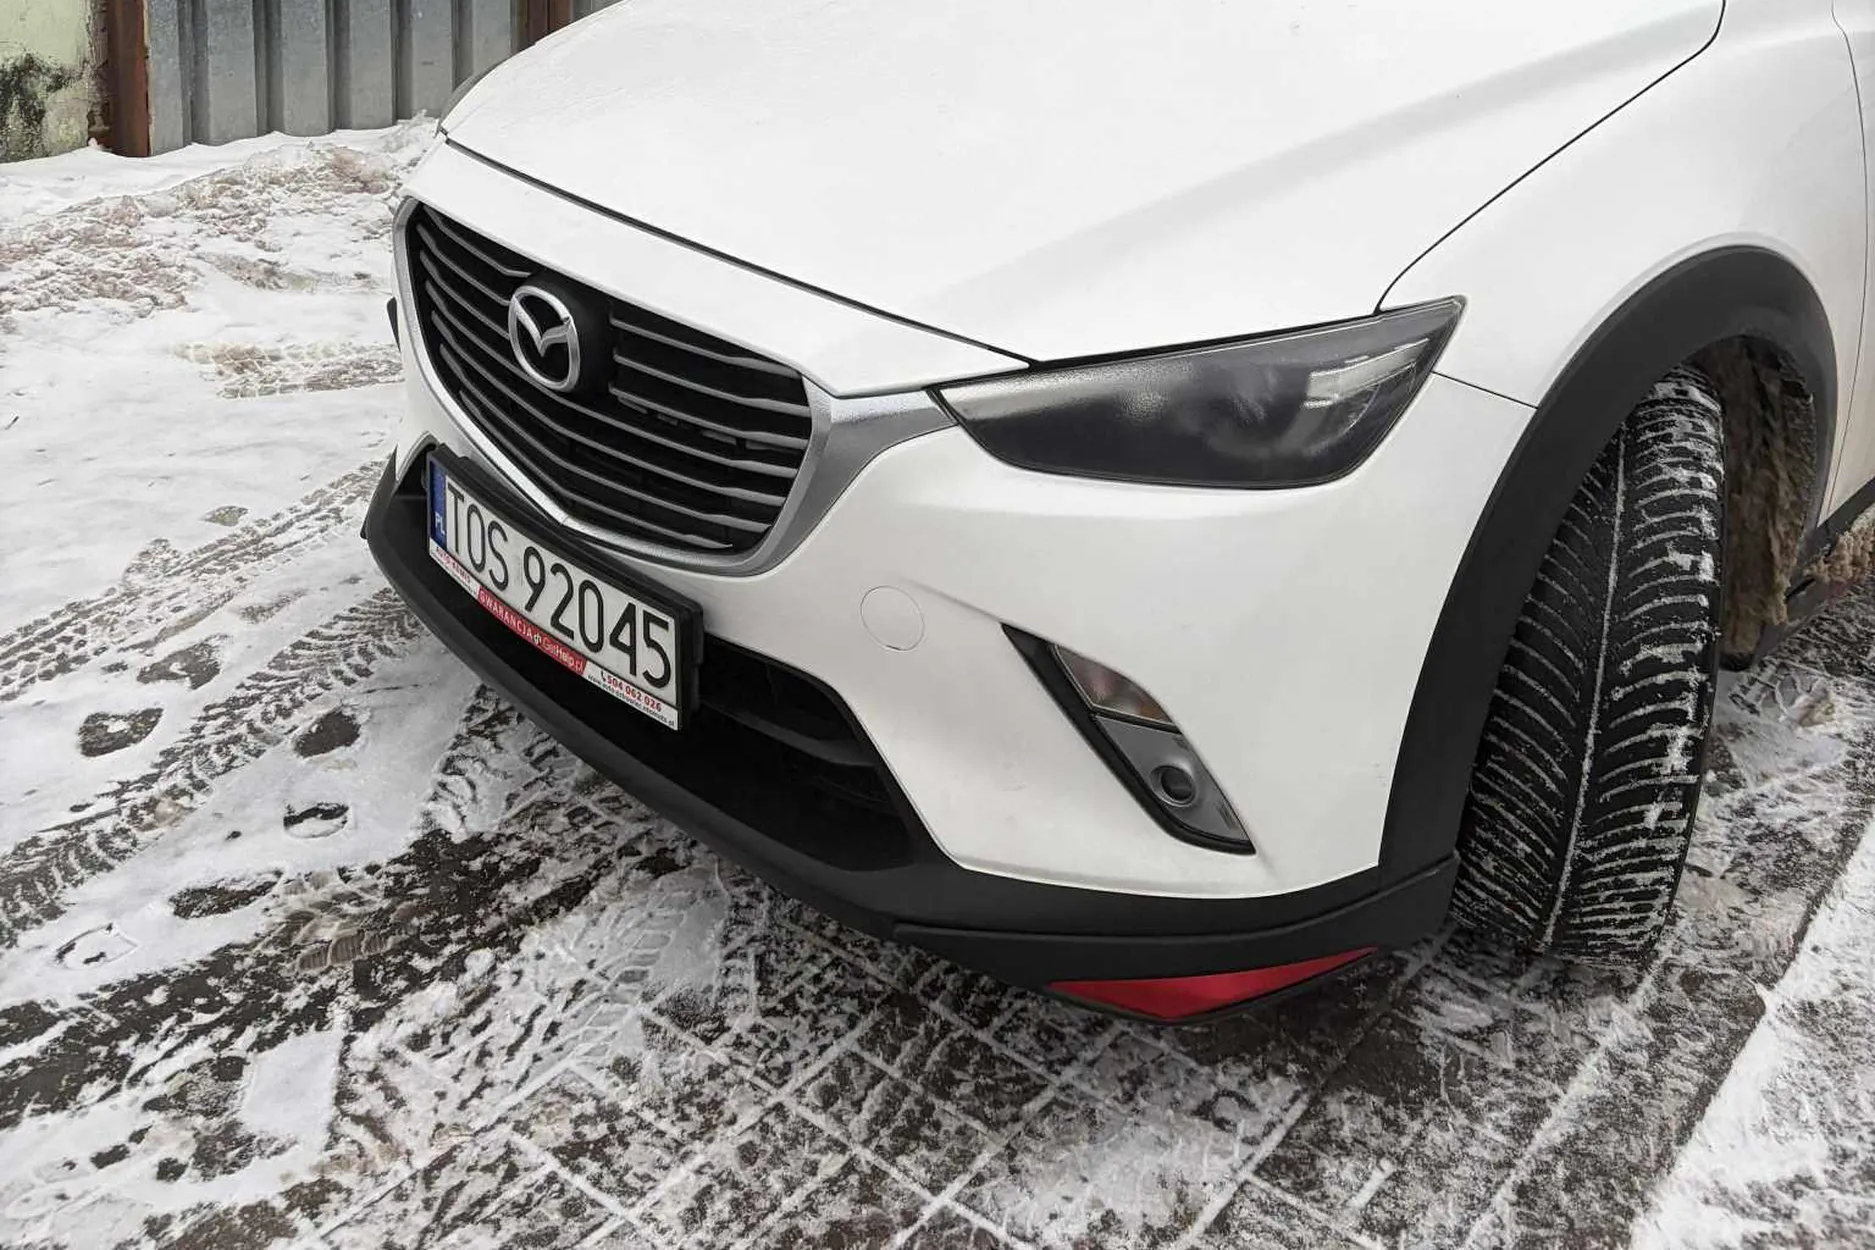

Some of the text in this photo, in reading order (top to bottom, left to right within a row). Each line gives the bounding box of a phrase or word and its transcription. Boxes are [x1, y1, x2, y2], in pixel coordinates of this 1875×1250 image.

[435, 512, 446, 536] PL
[446, 482, 671, 688] TOS 92045
[479, 590, 533, 641] GWARANCJA
